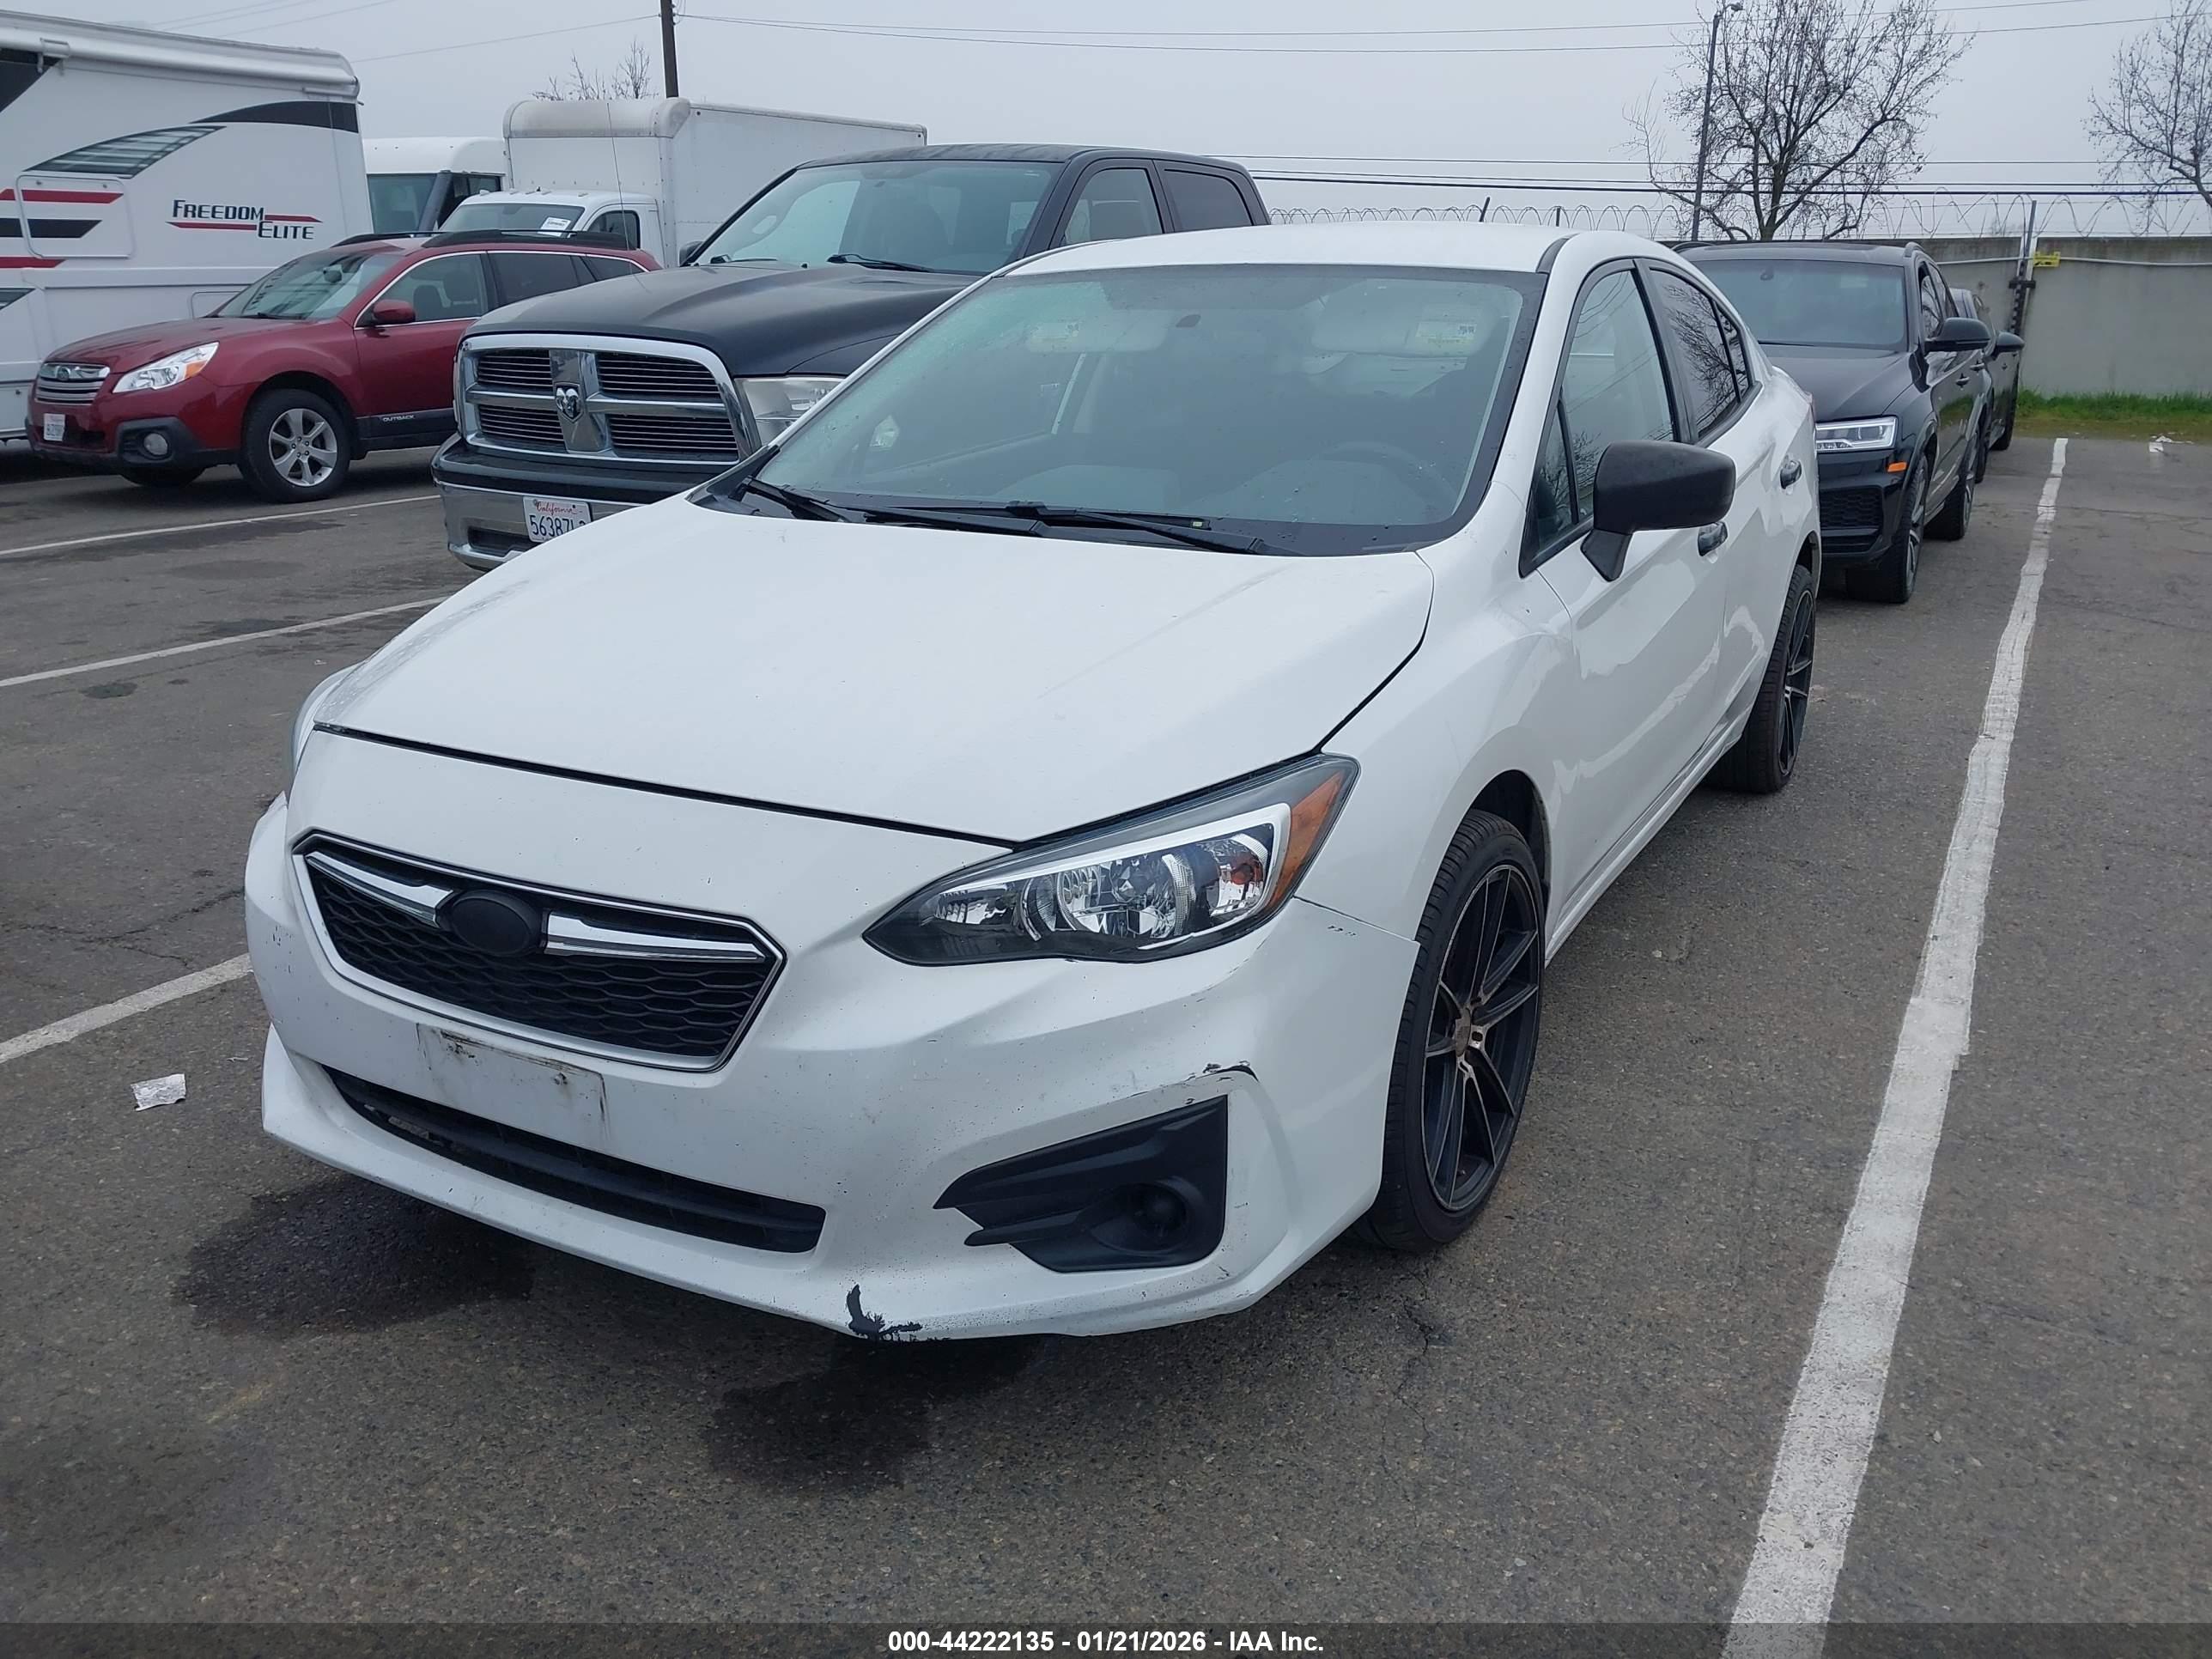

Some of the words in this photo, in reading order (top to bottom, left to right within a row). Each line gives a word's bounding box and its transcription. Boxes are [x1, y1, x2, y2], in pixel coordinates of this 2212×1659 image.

[173, 199, 264, 221] FREEDOM
[258, 221, 315, 240] ELITE
[536, 501, 574, 515] California
[529, 514, 586, 538] 56387
